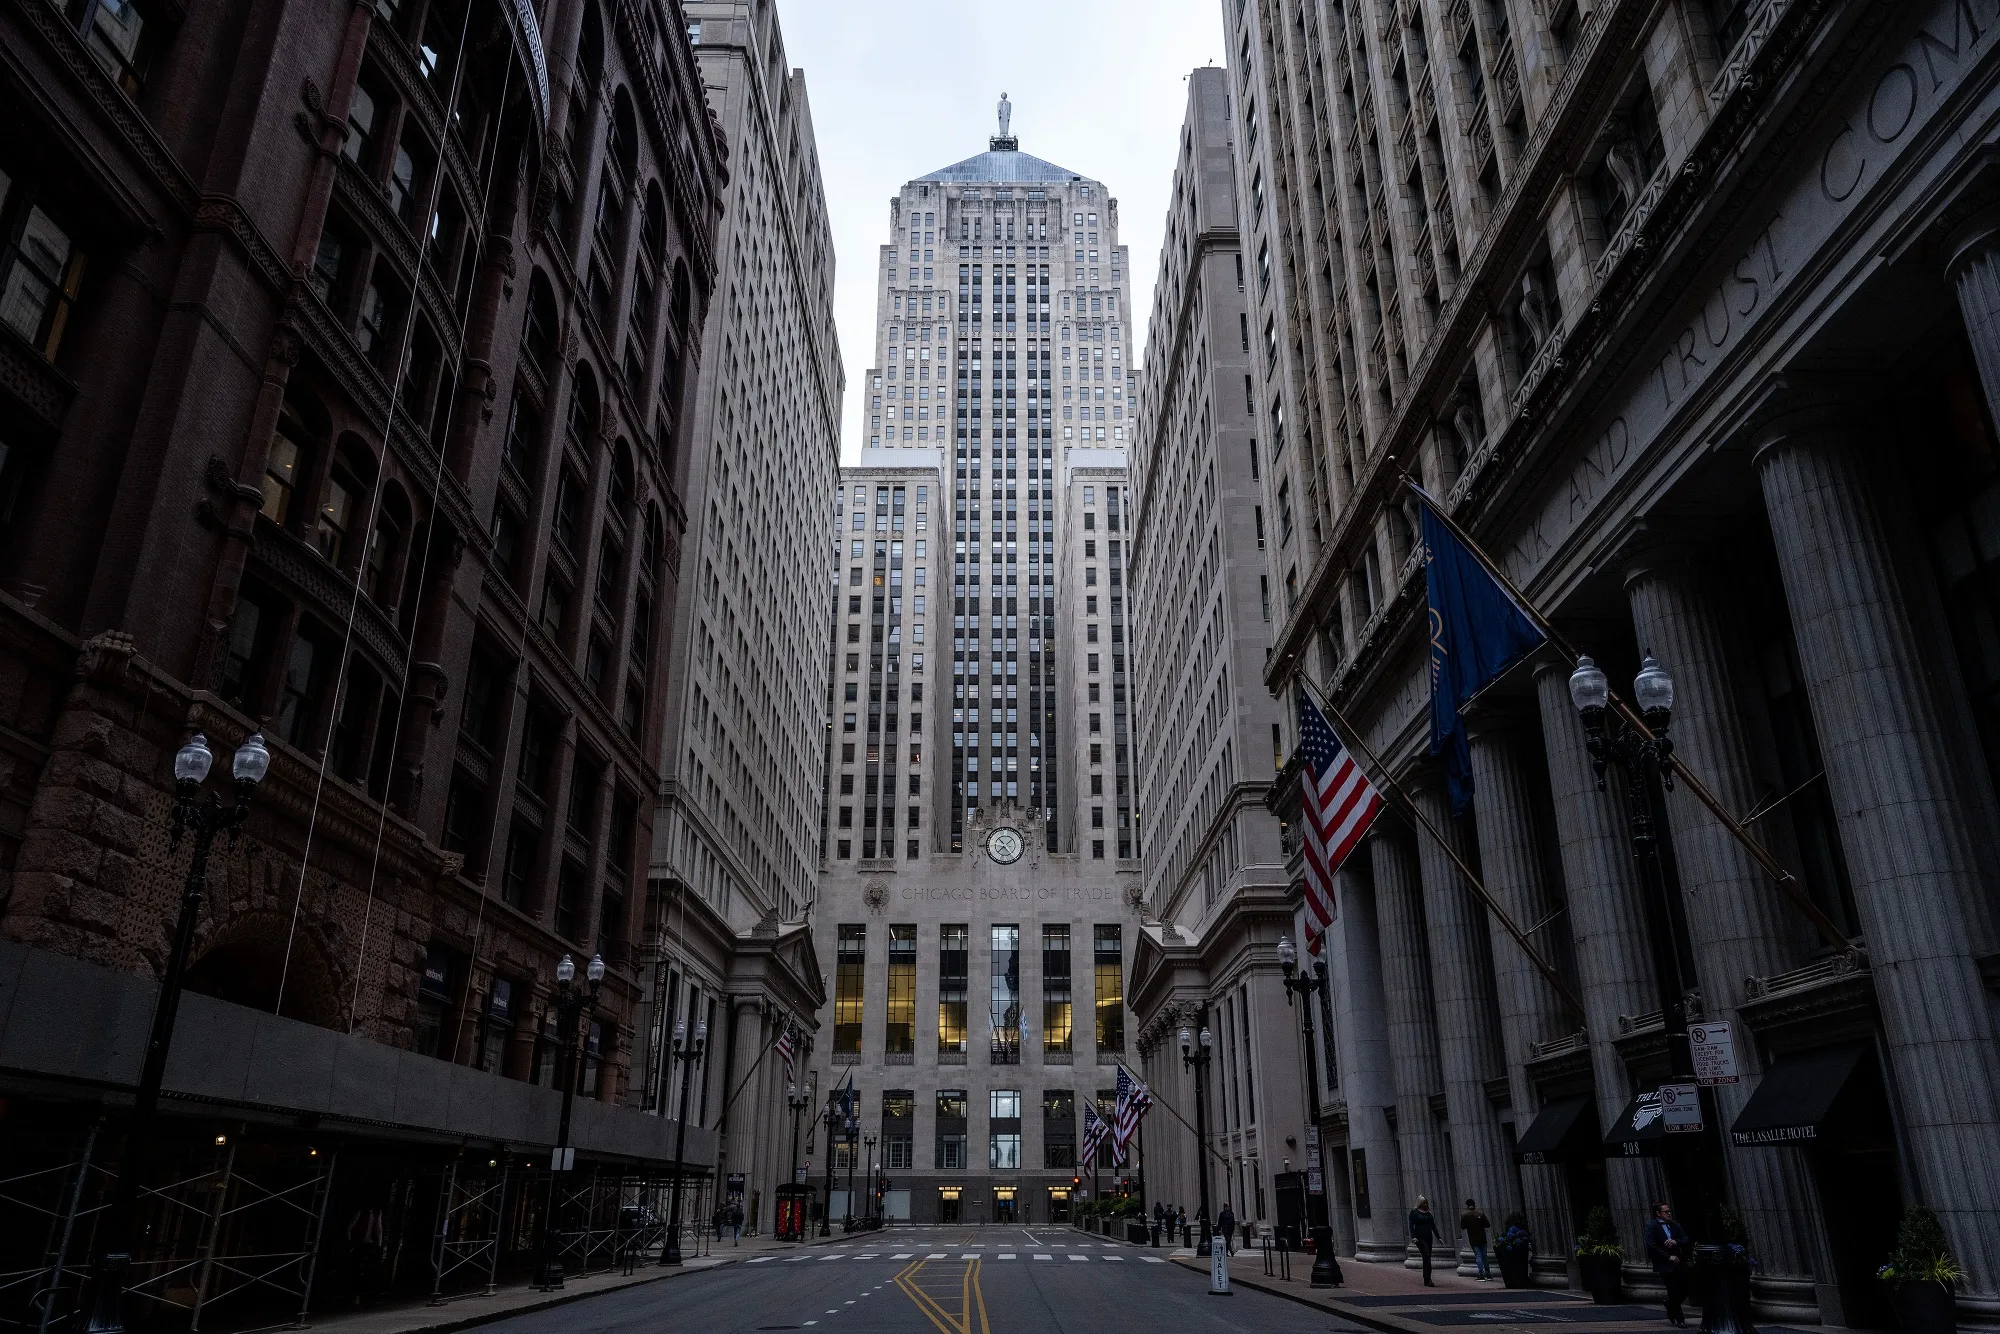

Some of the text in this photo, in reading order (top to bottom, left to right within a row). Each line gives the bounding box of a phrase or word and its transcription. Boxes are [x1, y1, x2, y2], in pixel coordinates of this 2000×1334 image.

[1569, 416, 1629, 524] AND
[1650, 211, 1783, 410] TRUST
[1820, 0, 2000, 203] COM
[901, 887, 1113, 901] CHICAGO BOARD OF TRADE
[1636, 1092, 1654, 1102] THE
[1733, 1125, 1817, 1144] THE LASALLE HOTEL
[1623, 1141, 1640, 1155] 208
